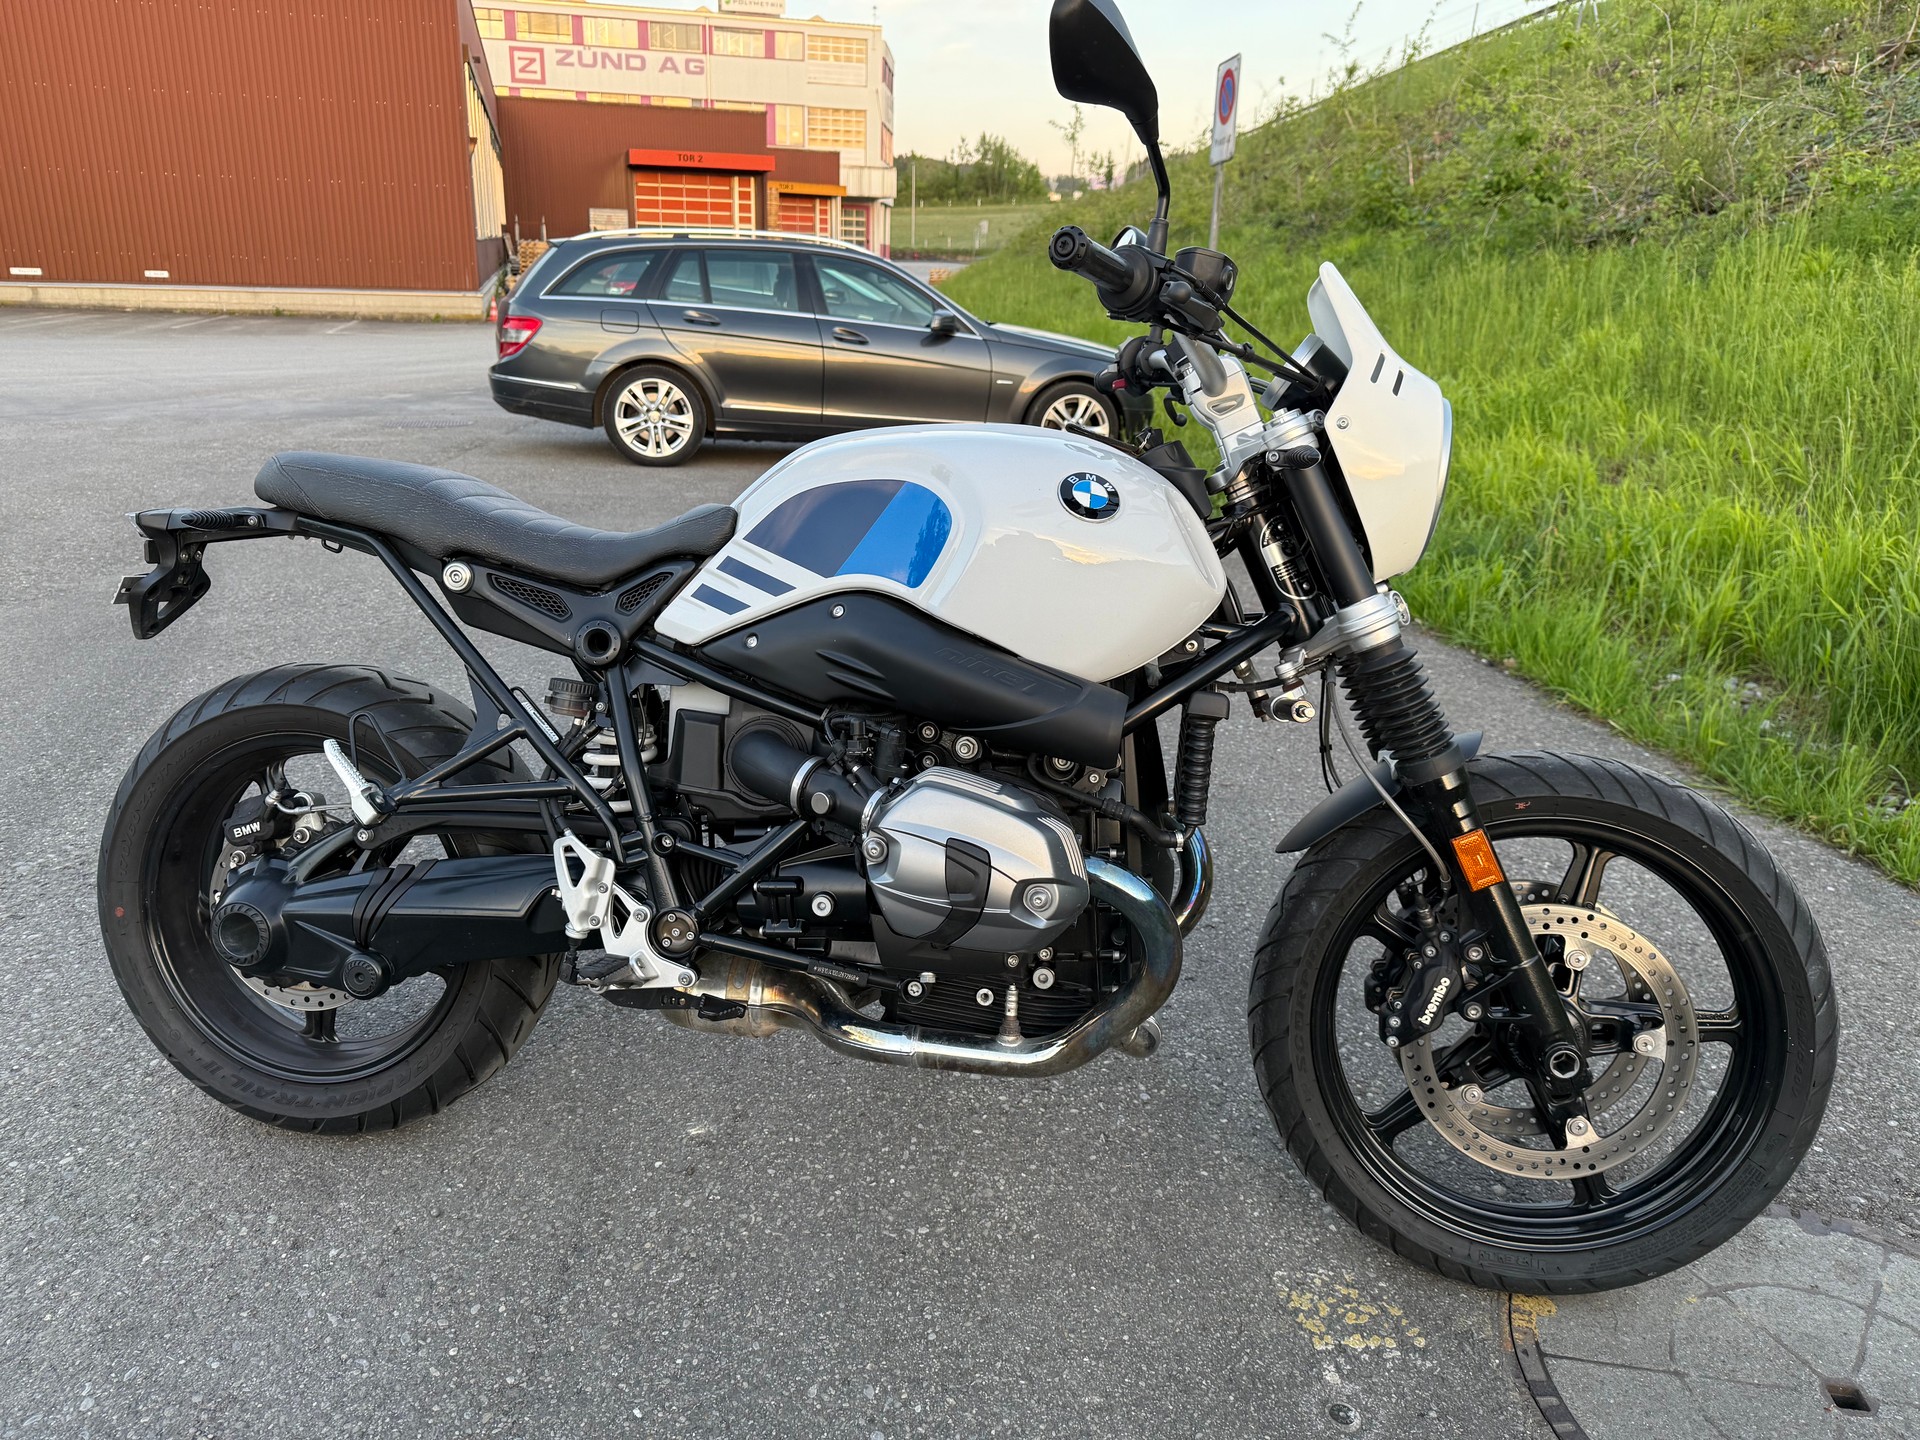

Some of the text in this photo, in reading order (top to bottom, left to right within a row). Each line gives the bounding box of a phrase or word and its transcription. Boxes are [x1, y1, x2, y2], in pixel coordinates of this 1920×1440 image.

[517, 56, 538, 74] Z
[555, 46, 705, 76] ZÜND AG
[677, 153, 704, 163] TOR 2
[1067, 473, 1116, 492] BMW
[233, 821, 261, 838] BMW
[1418, 977, 1451, 1025] brembo
